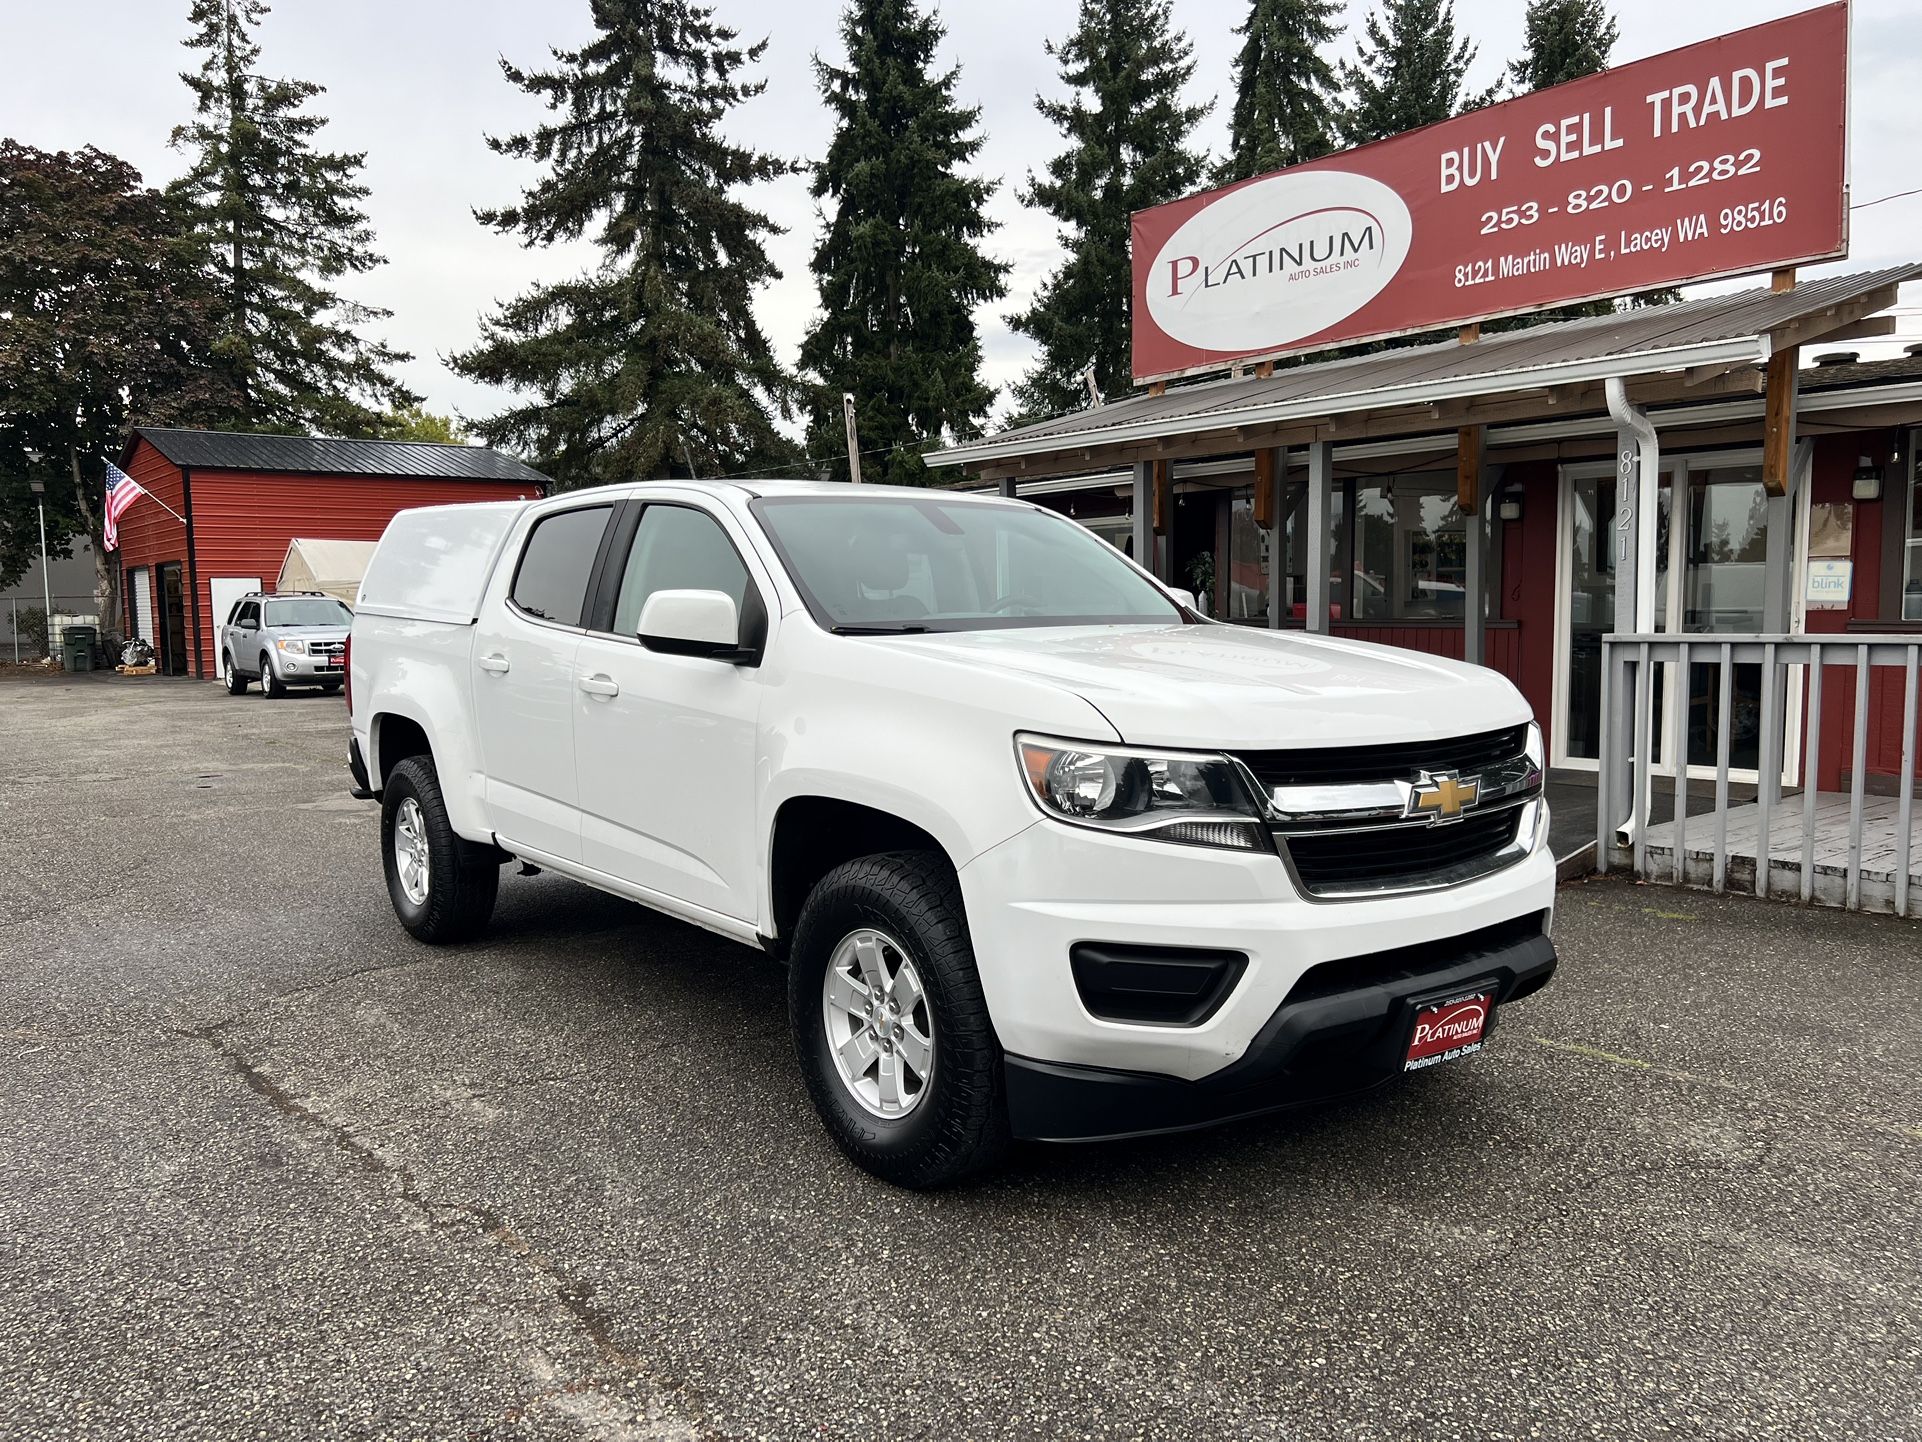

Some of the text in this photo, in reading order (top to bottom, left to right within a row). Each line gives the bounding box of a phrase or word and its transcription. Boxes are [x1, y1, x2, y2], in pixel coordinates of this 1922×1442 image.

[1440, 57, 1789, 194] BUY SELL TRADE
[1480, 201, 1539, 235] 253
[1567, 179, 1633, 214] 820
[1664, 149, 1761, 192] 1282
[1167, 226, 1374, 297] PLATINUM
[1288, 258, 1360, 282] AUTO SALES INC
[1454, 259, 1494, 288] 8121
[1499, 250, 1549, 279] Martin
[1555, 239, 1590, 273] Way
[1620, 226, 1672, 255] Lacey
[1677, 214, 1708, 243] WA
[1719, 197, 1787, 234] 98516
[1617, 450, 1633, 561] 8121
[1812, 577, 1844, 589] blink
[1404, 1042, 1481, 1071] Platinum Auto Sales
[1412, 1016, 1483, 1045] PLATINUM
